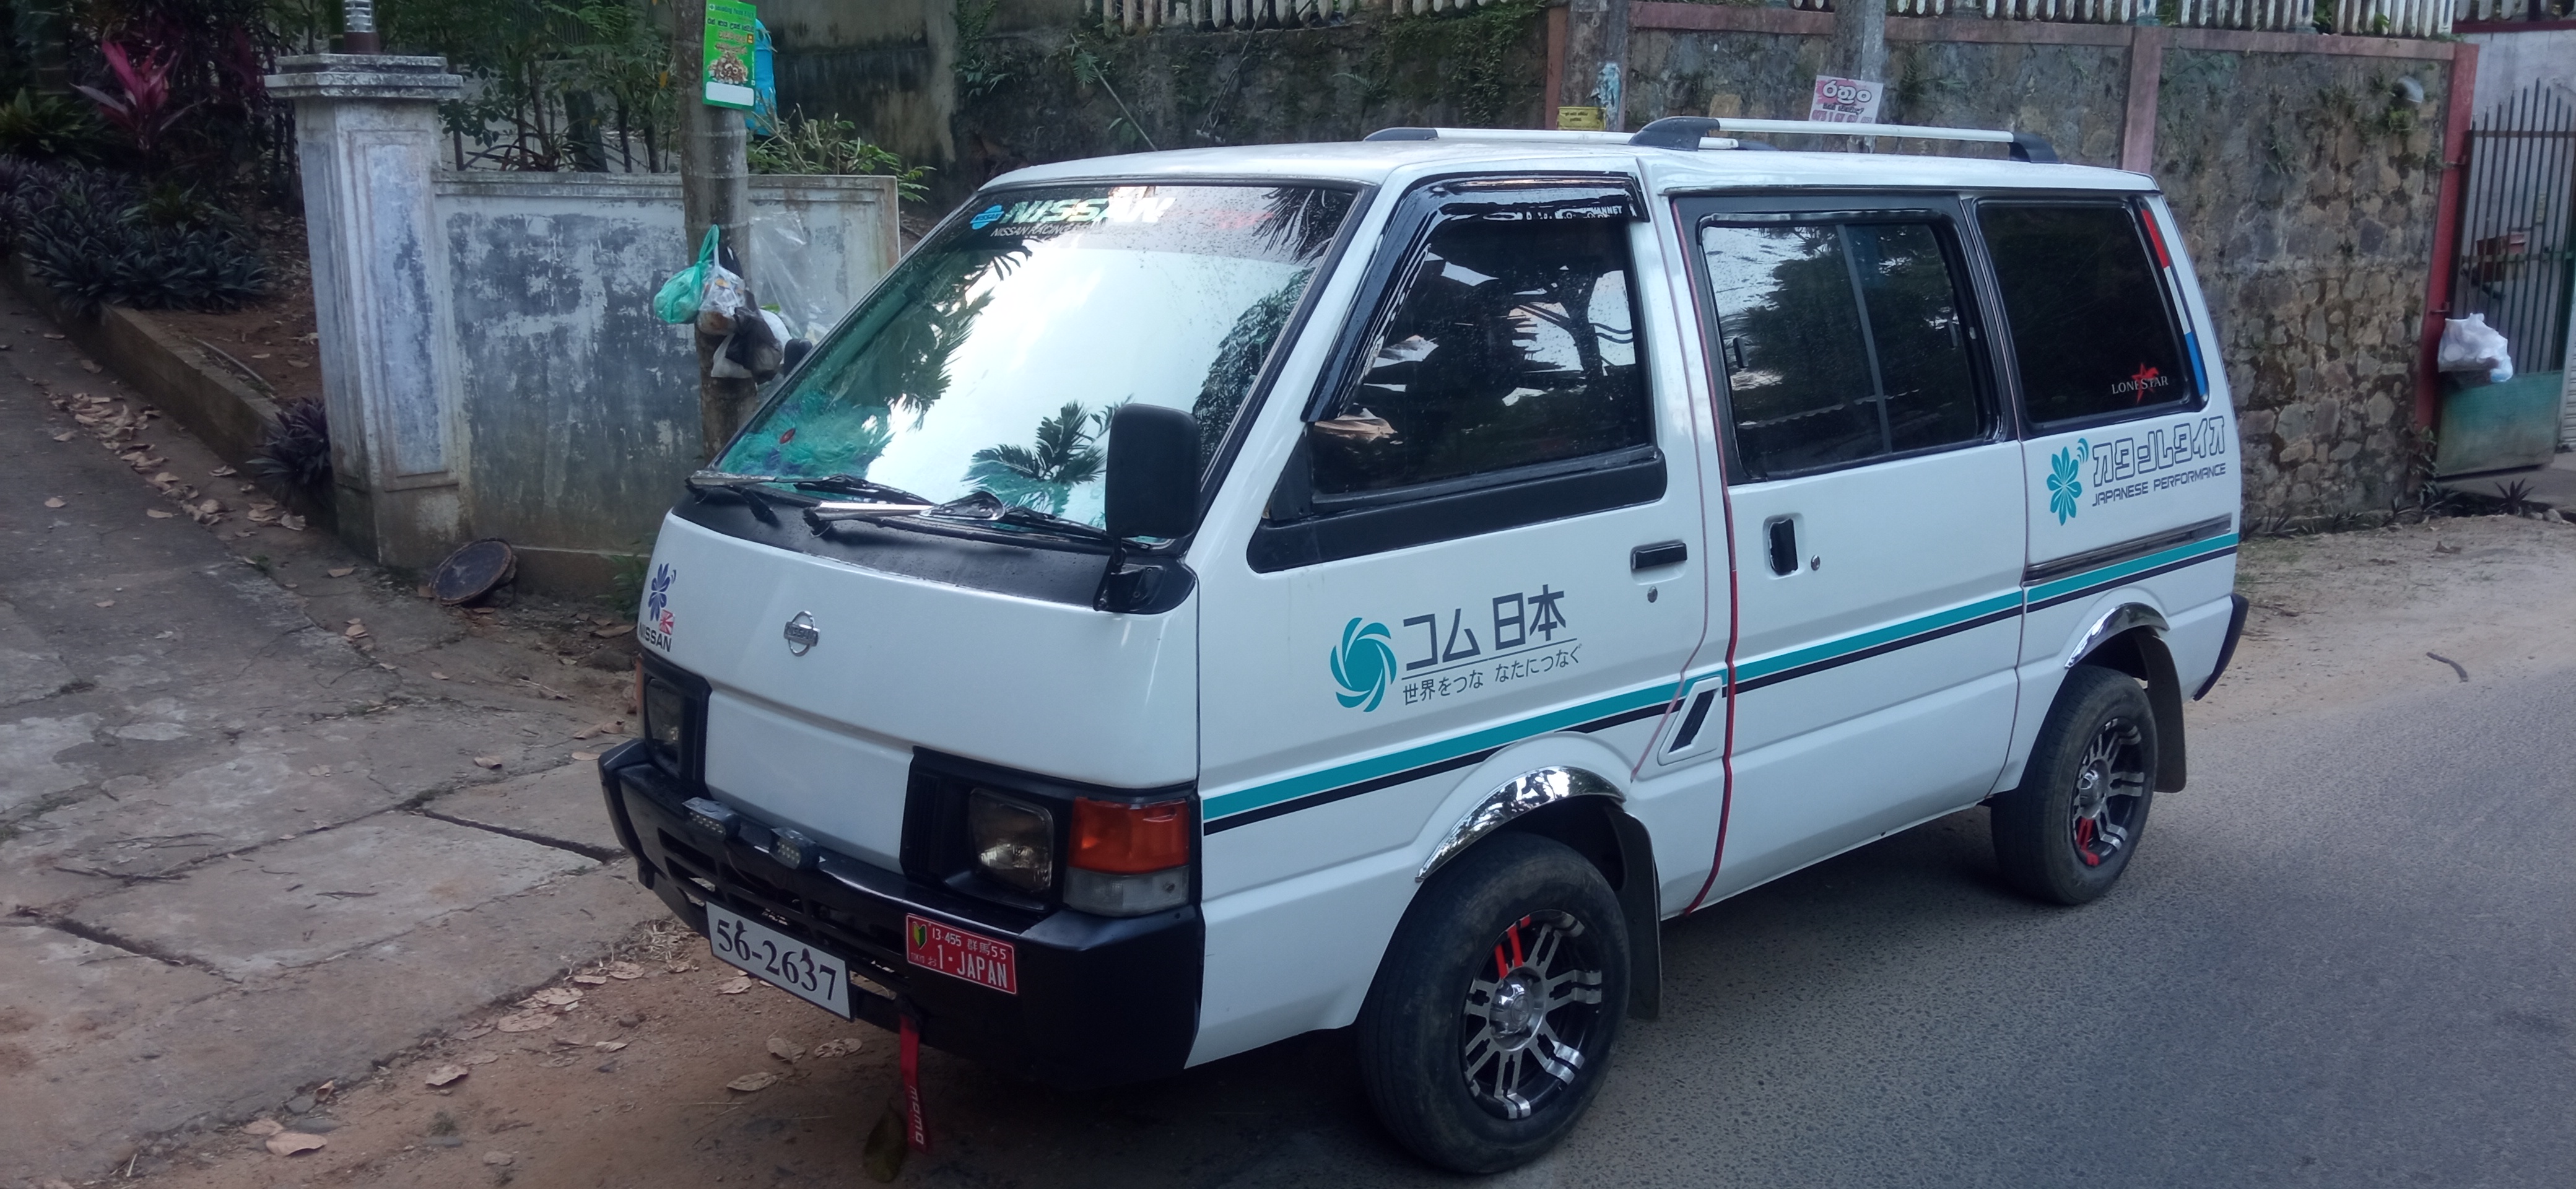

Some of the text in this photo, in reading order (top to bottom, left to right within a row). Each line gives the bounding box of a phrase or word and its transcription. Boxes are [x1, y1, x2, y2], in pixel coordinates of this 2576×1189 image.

[999, 198, 1176, 224] NISSAN
[990, 227, 1030, 237] NISSAN
[1028, 223, 1069, 235] RACING
[2092, 463, 2226, 507] JAPANESE PERFORMANCE
[638, 622, 672, 652] NISSAN
[1403, 584, 1567, 671] コム 日本
[1403, 669, 1484, 706] 世界をつな
[717, 919, 837, 1001] 56-2637
